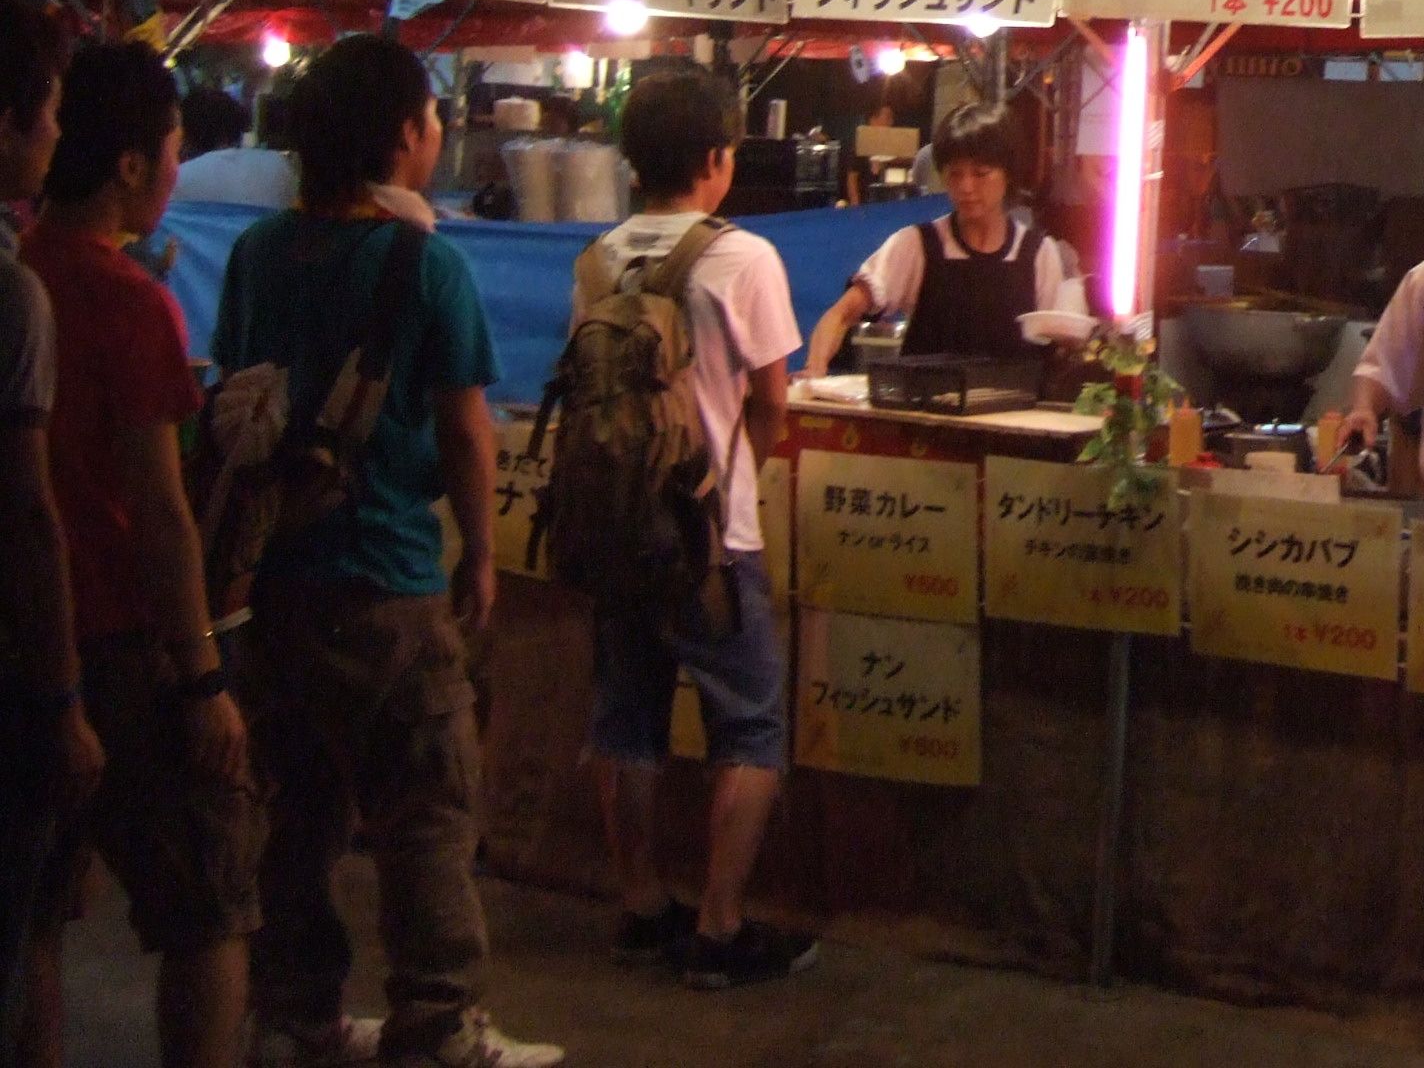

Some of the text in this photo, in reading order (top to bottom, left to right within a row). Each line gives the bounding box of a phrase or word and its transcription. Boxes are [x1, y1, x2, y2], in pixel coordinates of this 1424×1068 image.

[824, 485, 946, 519] 野菜カレー
[1228, 527, 1359, 569] シシカバブ
